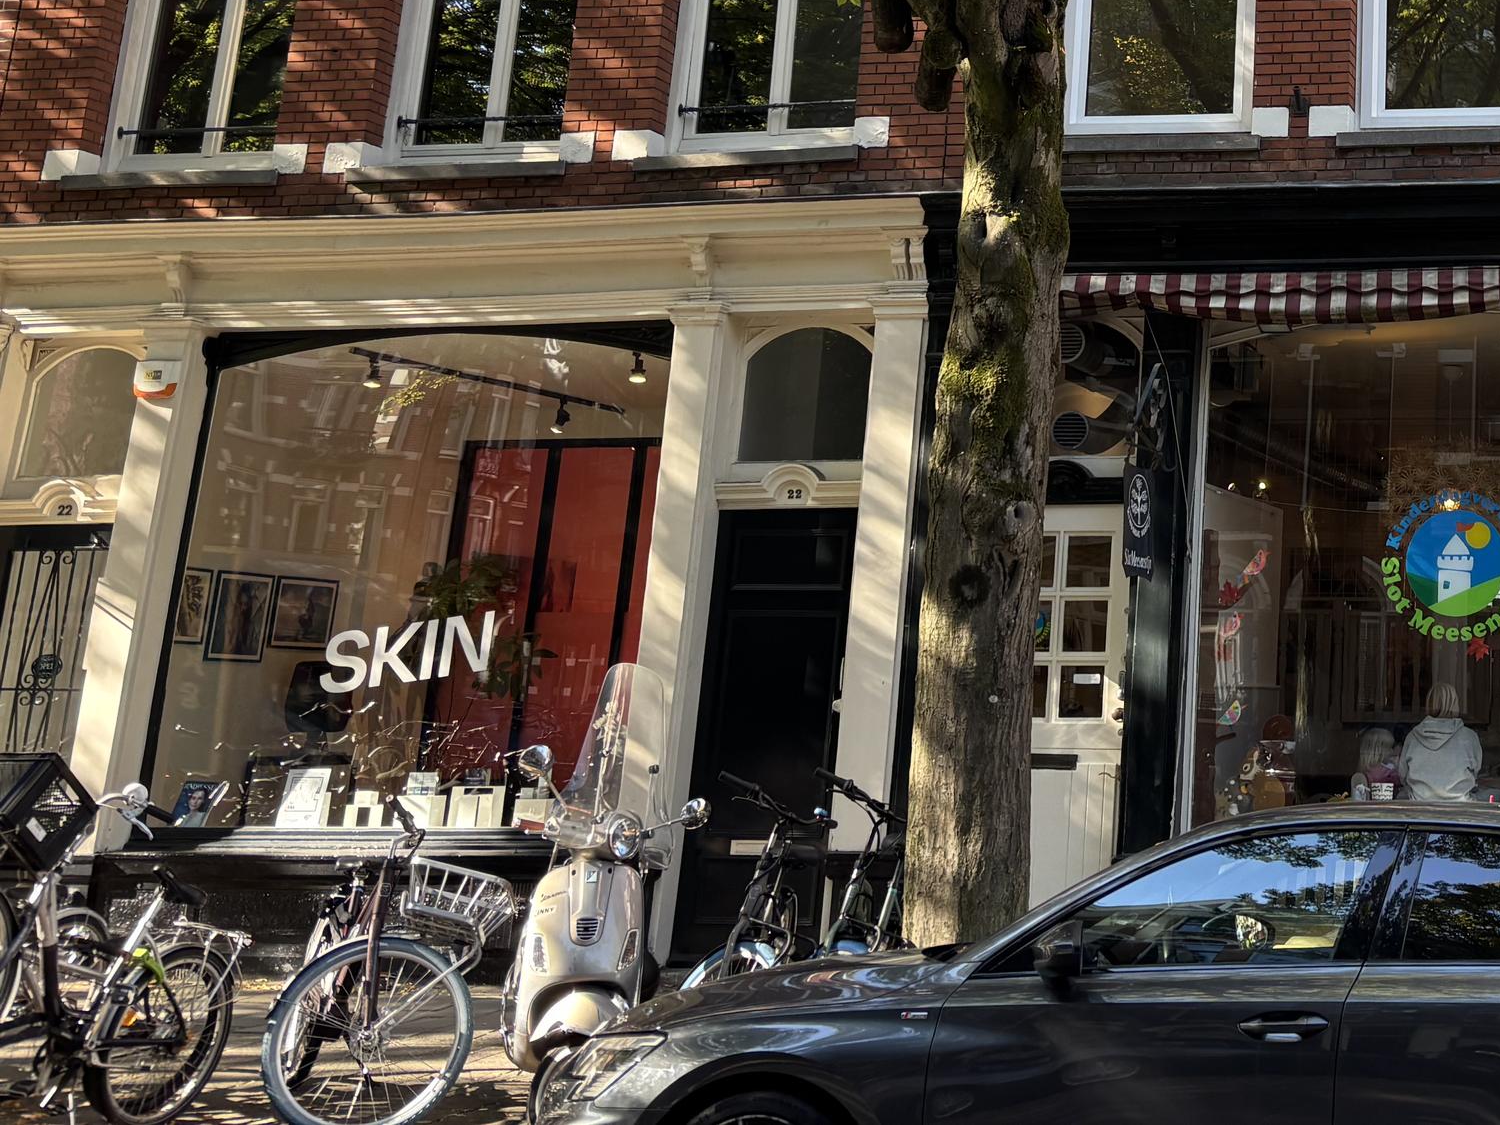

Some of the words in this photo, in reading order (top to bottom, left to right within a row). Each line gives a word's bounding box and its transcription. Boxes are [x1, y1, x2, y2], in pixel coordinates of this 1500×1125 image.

[57, 504, 73, 516] 22
[787, 489, 802, 500] 22
[1380, 556, 1413, 615] Slot
[319, 610, 496, 694] SKIN
